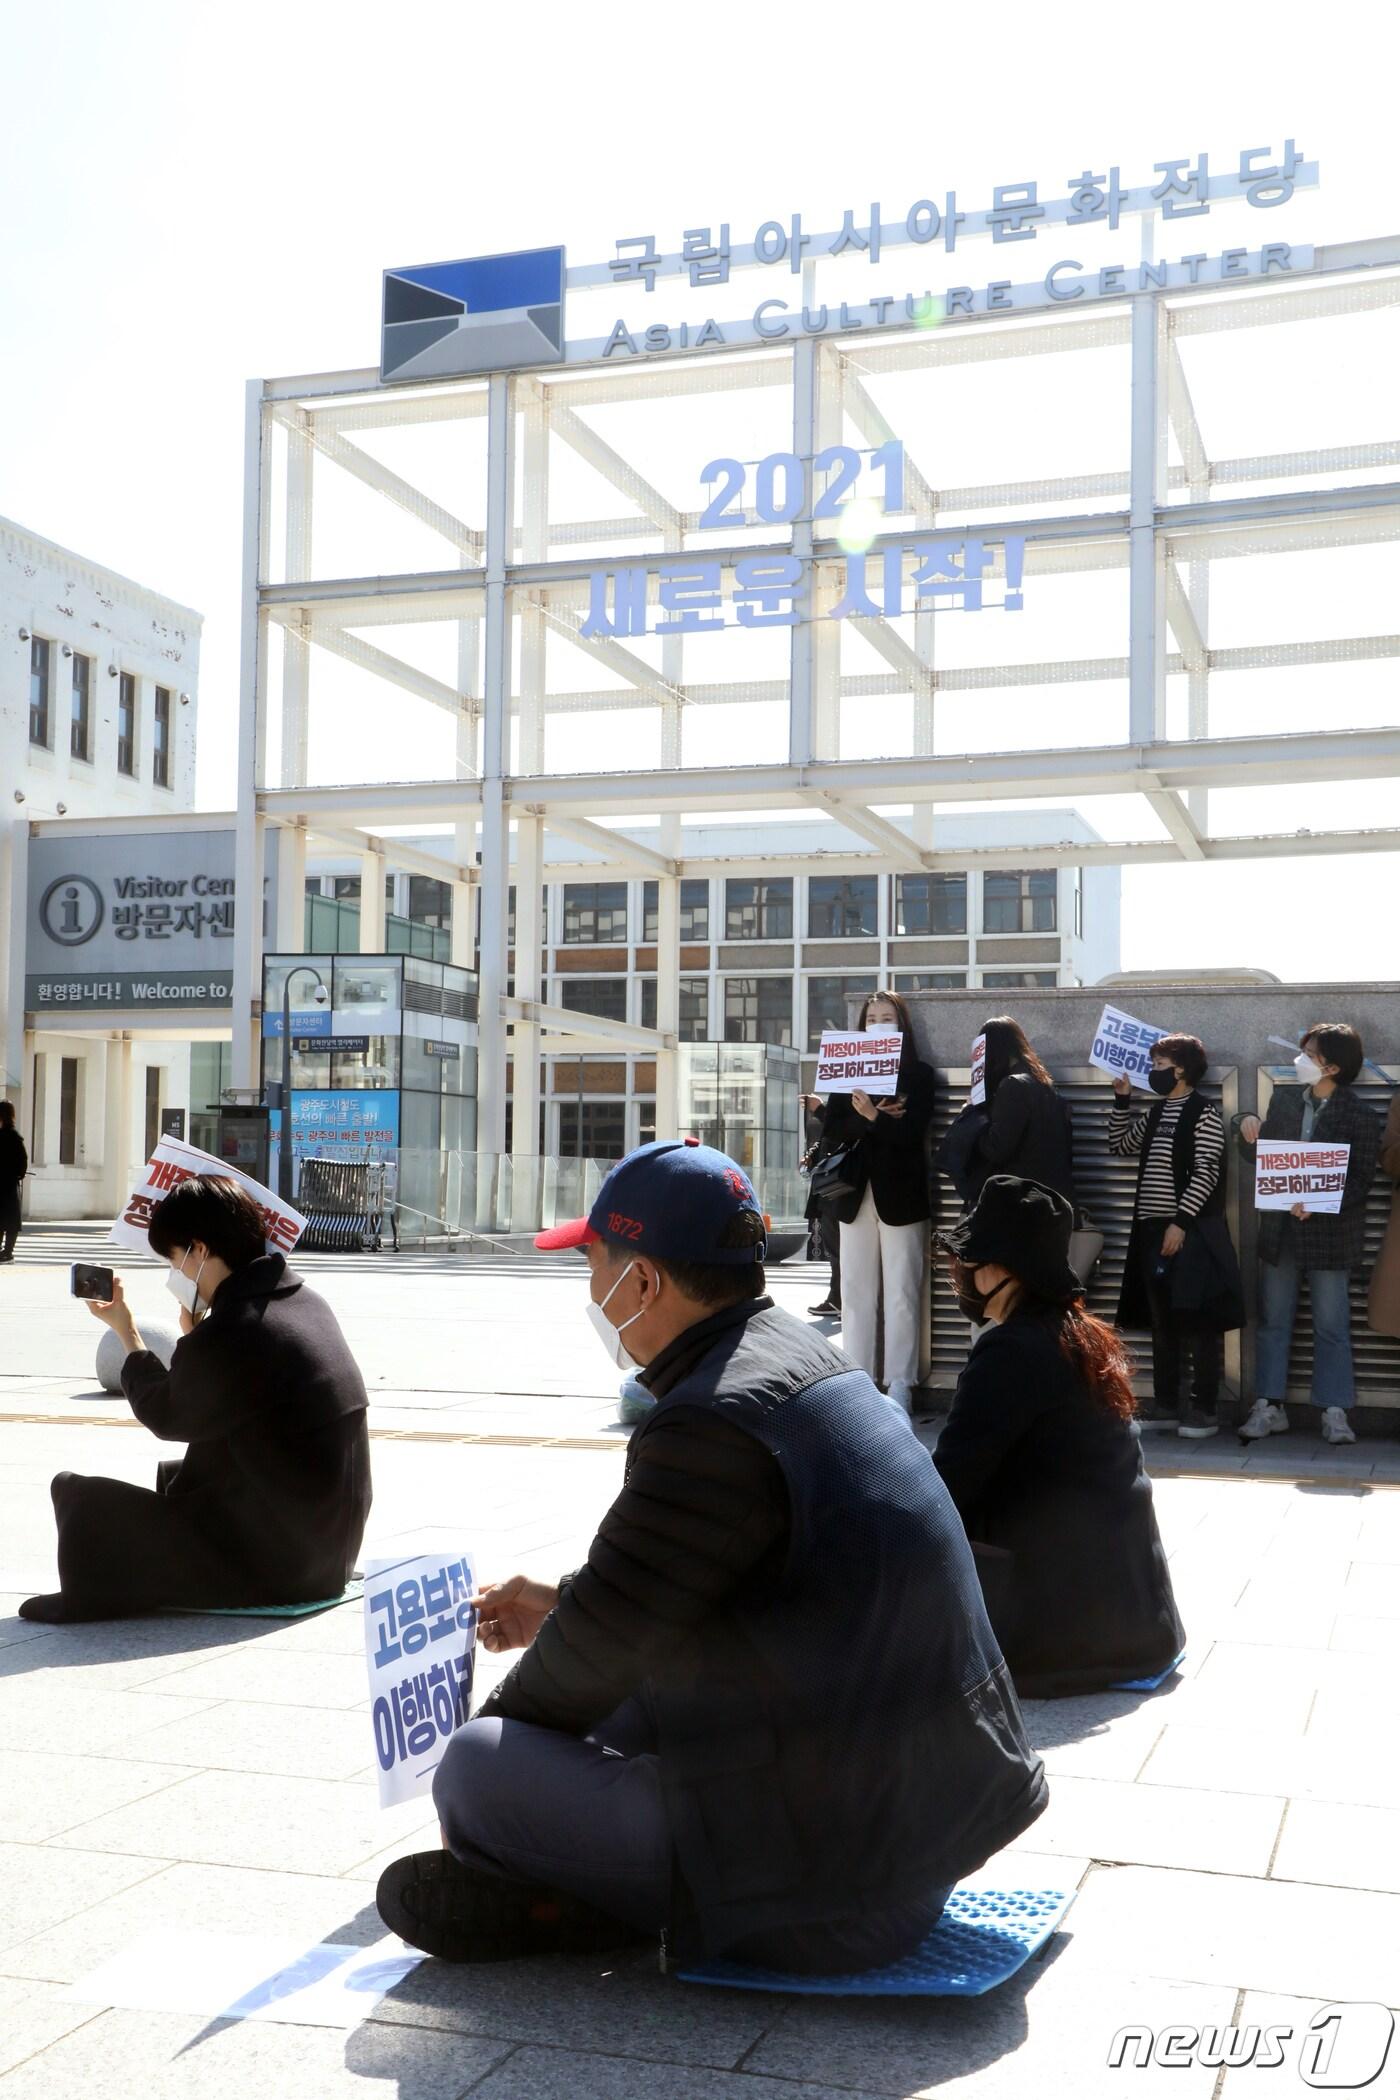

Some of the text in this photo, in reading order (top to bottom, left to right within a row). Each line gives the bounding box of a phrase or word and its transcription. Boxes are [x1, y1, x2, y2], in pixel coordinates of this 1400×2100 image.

[609, 138, 1304, 292] 국립아시아문화전당
[1044, 242, 1292, 301] CENTER
[700, 439, 904, 529] 2021
[578, 536, 1026, 639] 새로운 시작!
[113, 875, 188, 899] Visitor
[38, 982, 122, 1001] 환영합니다!
[131, 982, 207, 999] Welcome
[209, 982, 228, 998] to
[1102, 1015, 1168, 1050] 고용보
[821, 1037, 902, 1059] 개정아특법은
[308, 1130, 337, 1142] 광주의
[340, 1130, 361, 1142] 빠른
[364, 1130, 394, 1143] 발전을
[1257, 1150, 1348, 1171] 개정아특법은
[1257, 1173, 1346, 1196] 정리해고법!
[608, 1212, 644, 1240] 1872
[369, 1557, 478, 1670] 고용보장
